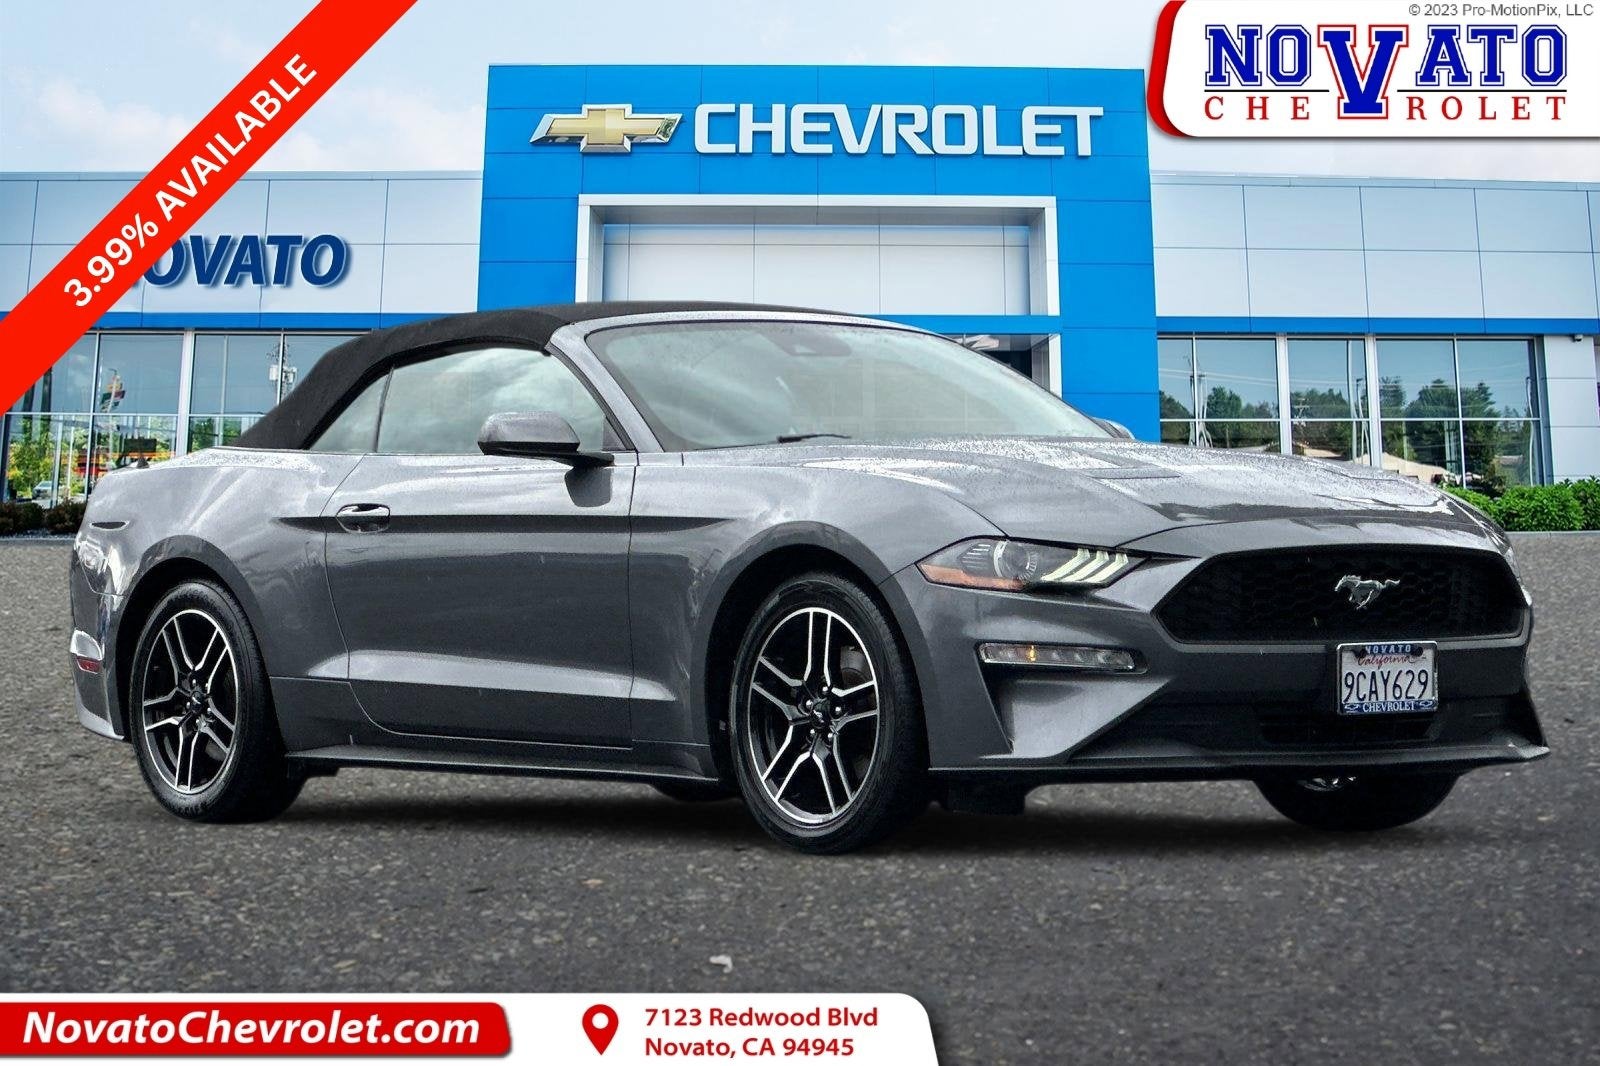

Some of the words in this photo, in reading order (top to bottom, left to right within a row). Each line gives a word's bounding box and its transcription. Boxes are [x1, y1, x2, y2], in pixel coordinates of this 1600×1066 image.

[694, 103, 1104, 156] CHEVROLET
[143, 234, 347, 287] OVATO
[1343, 669, 1429, 703] 9CAY629
[1362, 701, 1416, 713] CHEVROLET
